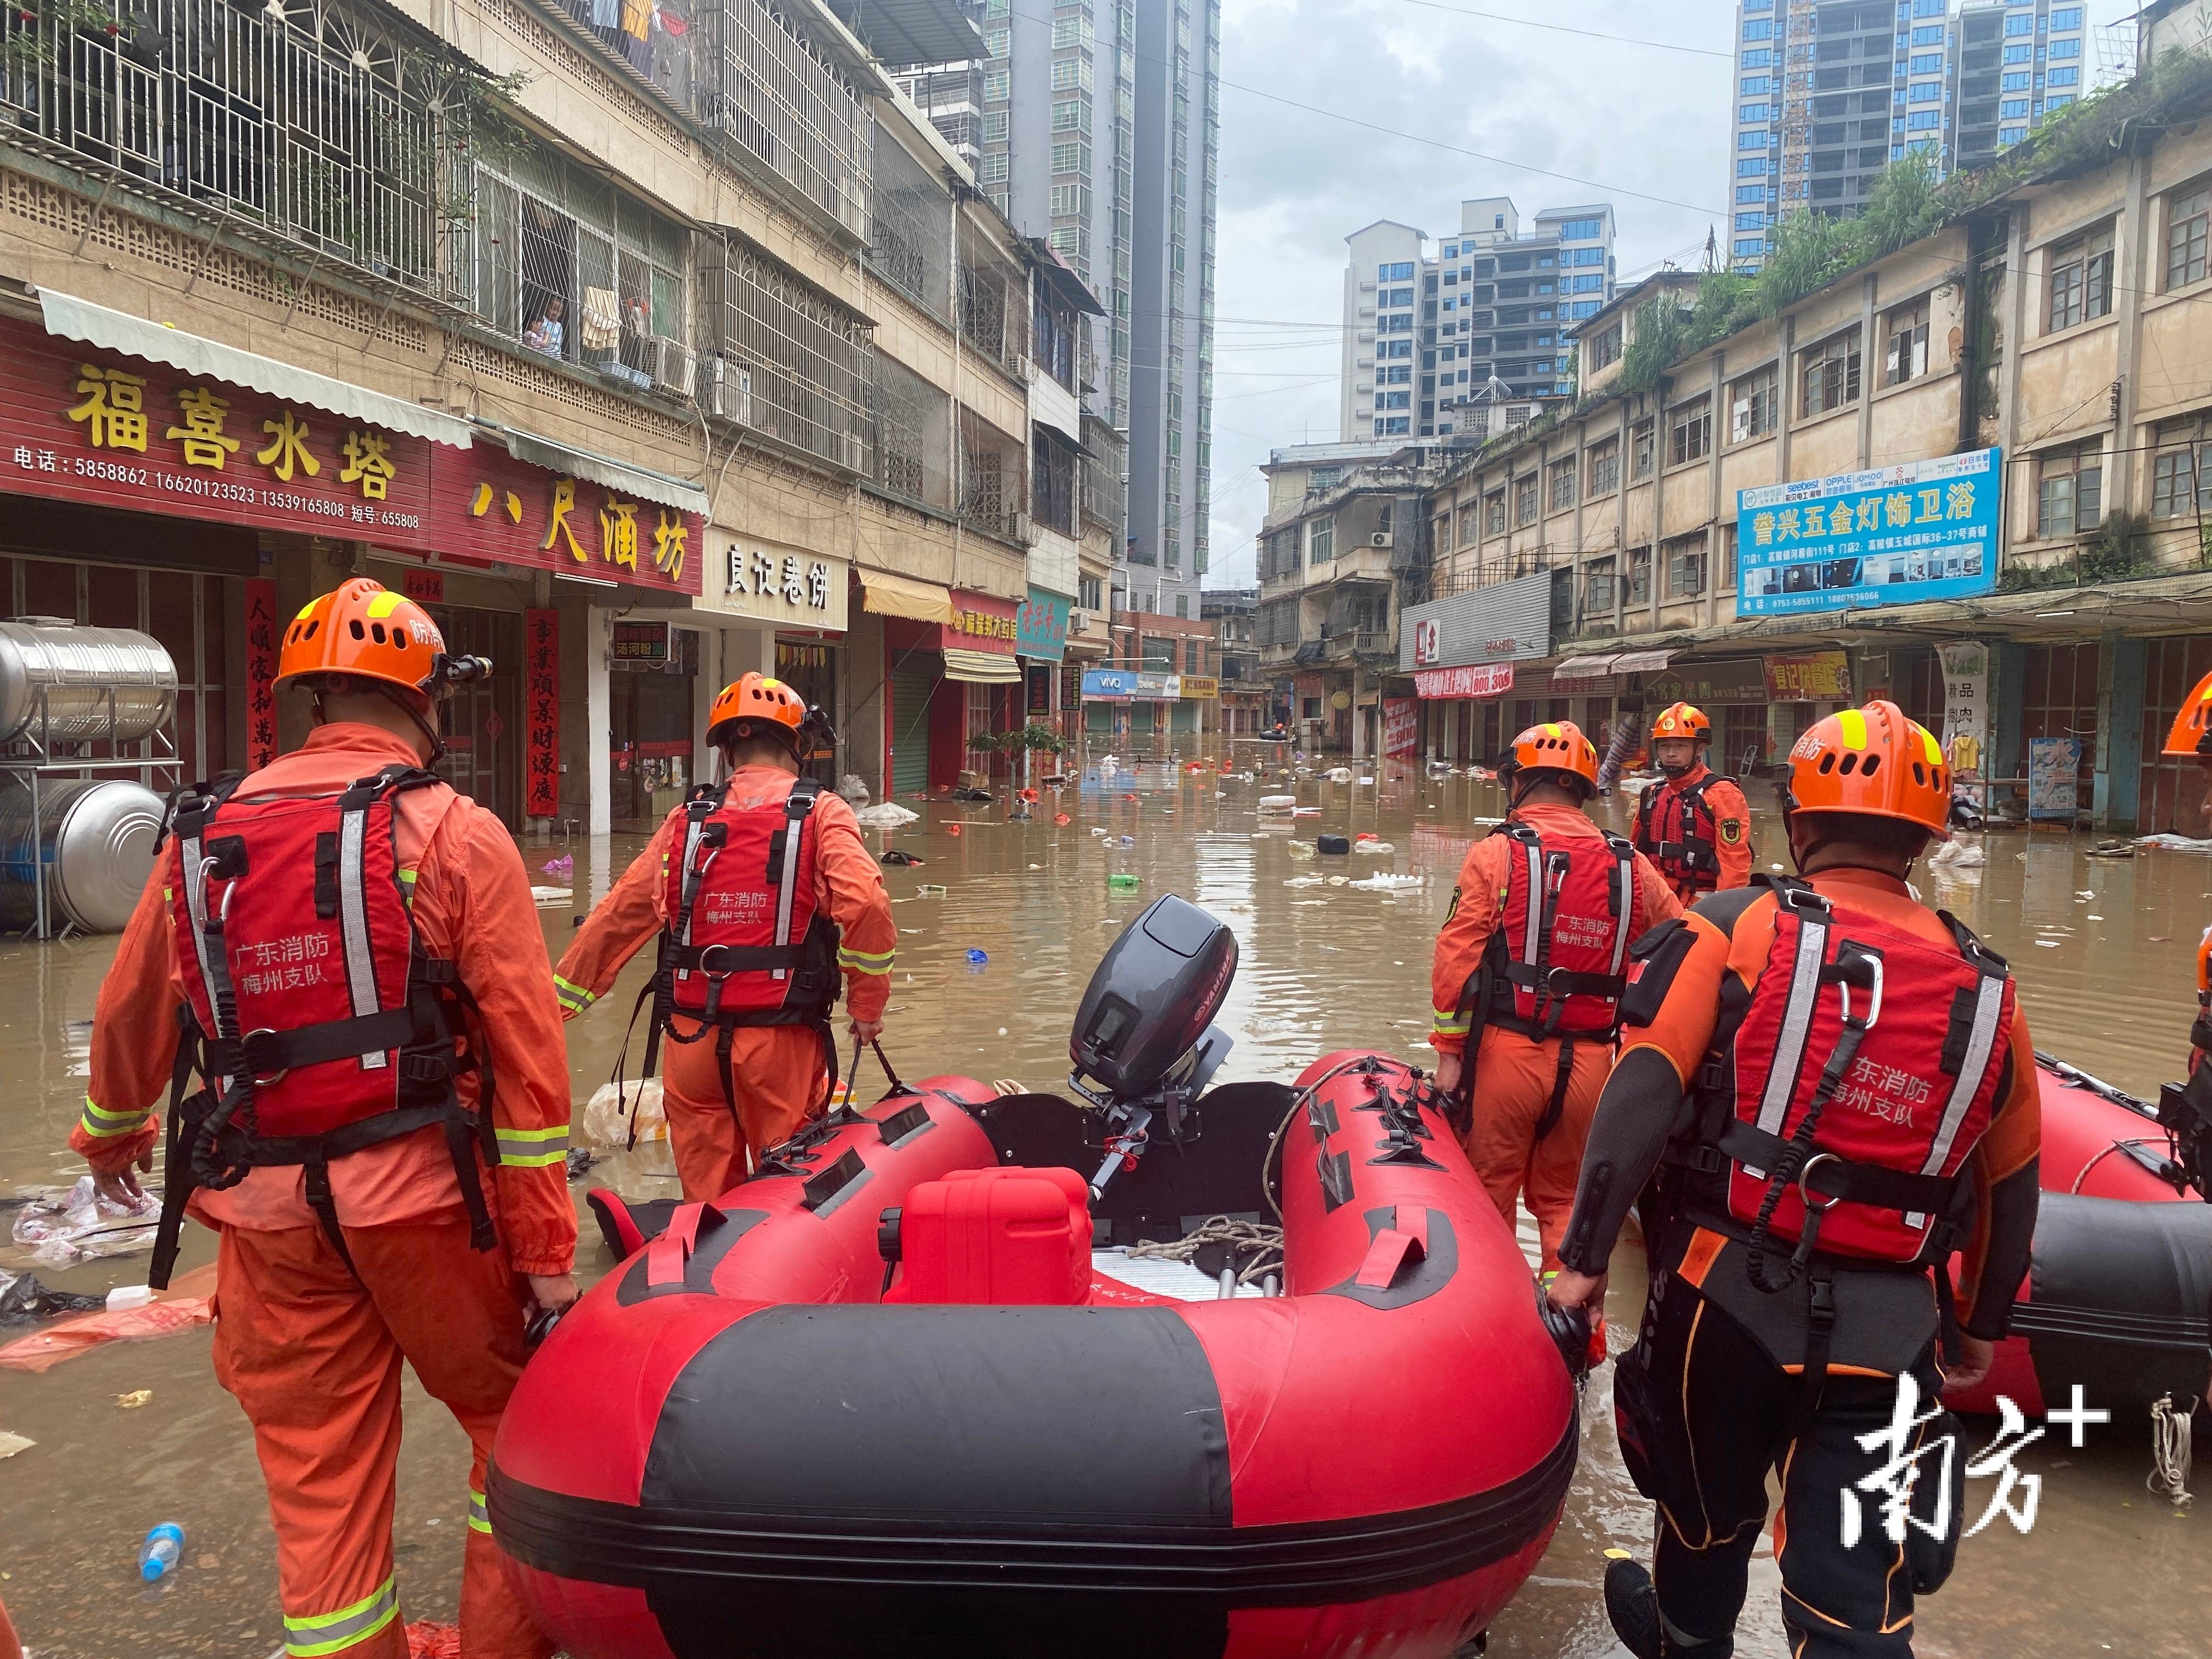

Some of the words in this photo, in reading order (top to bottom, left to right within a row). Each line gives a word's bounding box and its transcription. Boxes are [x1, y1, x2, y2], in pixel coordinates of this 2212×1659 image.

[67, 363, 397, 501] 福喜水塔
[1787, 479, 1820, 493] seebest
[1826, 475, 1853, 487] OPPLE
[1854, 472, 1882, 483] JOMOO
[155, 471, 255, 504] 16620123523
[261, 489, 345, 518] 13539165808
[1753, 481, 1976, 546] 誉兴五金灯饰卫浴
[472, 477, 689, 582] 八尺酒坊
[725, 544, 831, 610] 良记卷饼
[617, 642, 664, 656] 汤河粉面
[1474, 676, 1489, 693] 800
[1396, 724, 1417, 744] 800
[703, 891, 769, 908] 广东消防
[706, 910, 762, 924] 梅州支队
[1553, 913, 1611, 935] 广东消防
[235, 932, 330, 969] 广东消防
[1555, 930, 1604, 950] 梅州支队
[241, 962, 329, 996] 梅州支队
[1851, 1056, 1933, 1104] 东消防
